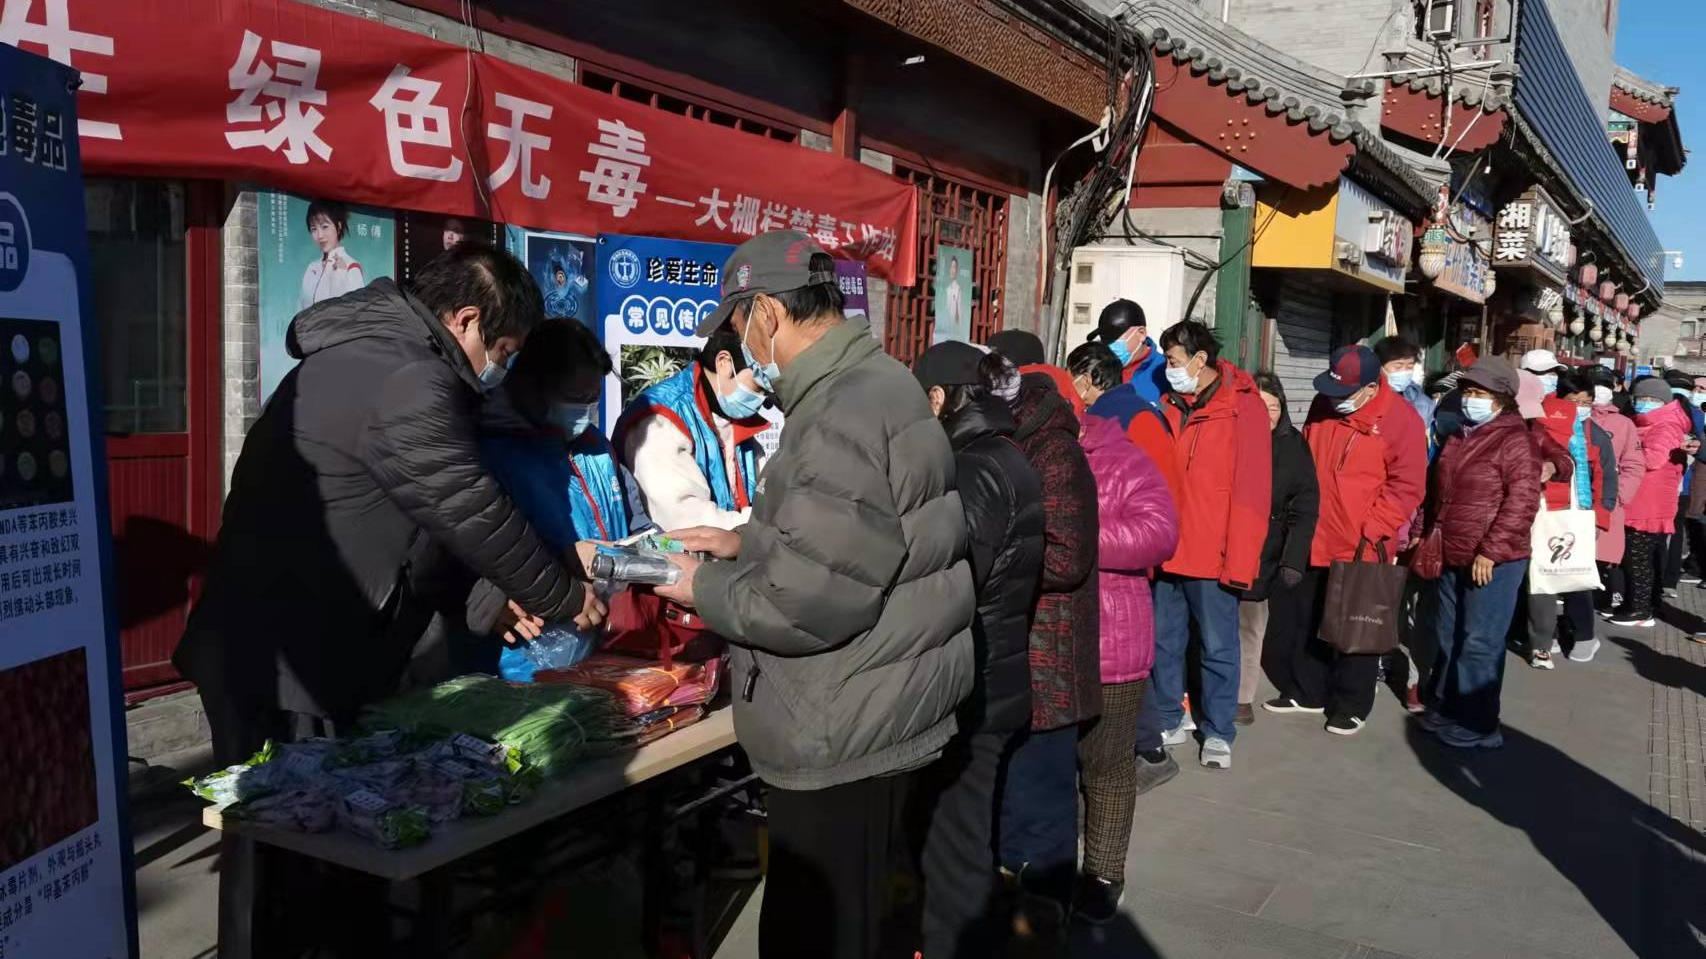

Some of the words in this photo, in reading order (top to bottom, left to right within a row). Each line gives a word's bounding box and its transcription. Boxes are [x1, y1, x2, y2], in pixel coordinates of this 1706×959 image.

[0, 96, 67, 171] 毒品
[1495, 203, 1531, 260] 湘菜
[646, 256, 719, 288] 珍爱生命
[628, 306, 713, 330] 常见传
